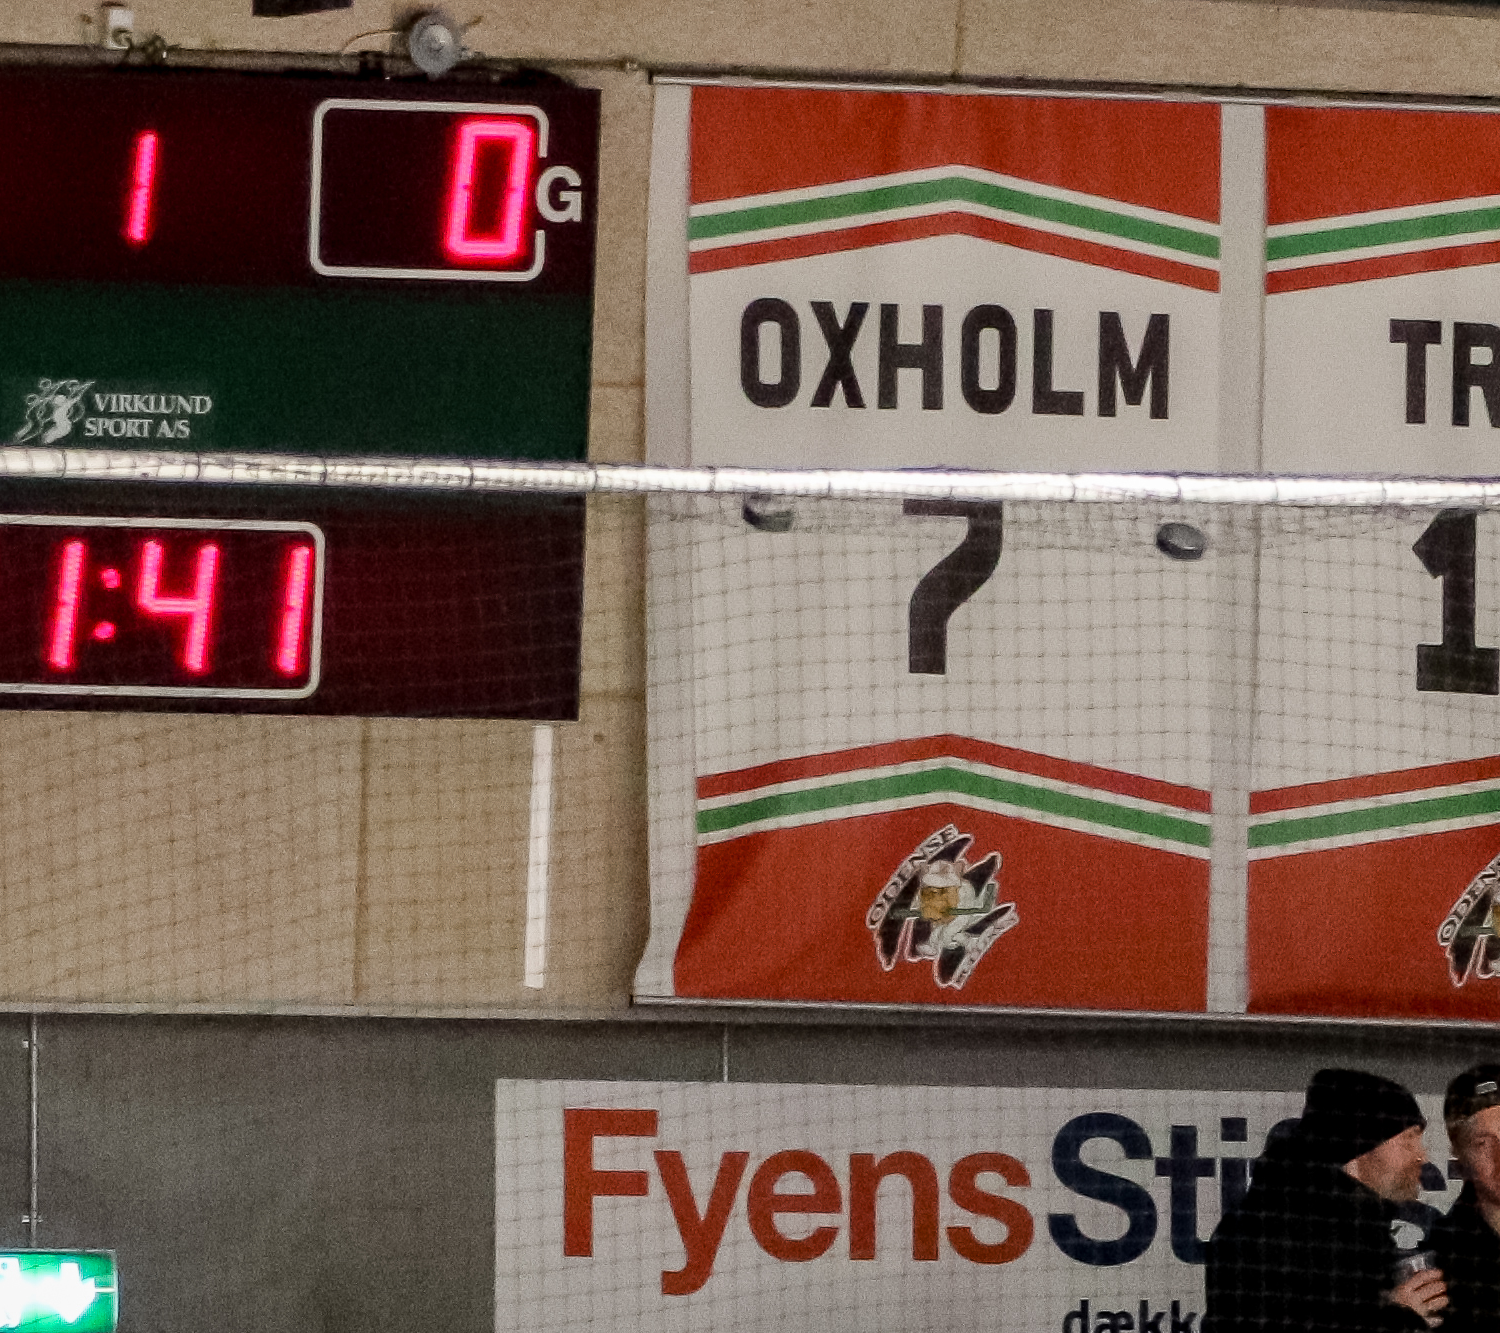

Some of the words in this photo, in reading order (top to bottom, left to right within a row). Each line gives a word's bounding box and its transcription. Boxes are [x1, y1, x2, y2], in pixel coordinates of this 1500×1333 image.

[444, 119, 536, 261] 0
[534, 166, 582, 224] G
[94, 392, 213, 416] VIRKLUND
[740, 296, 1171, 420] OXHOLM
[84, 418, 154, 440] SPORT
[156, 418, 192, 440] A/S
[902, 498, 1004, 675] 7
[563, 1107, 1036, 1298] Fyens
